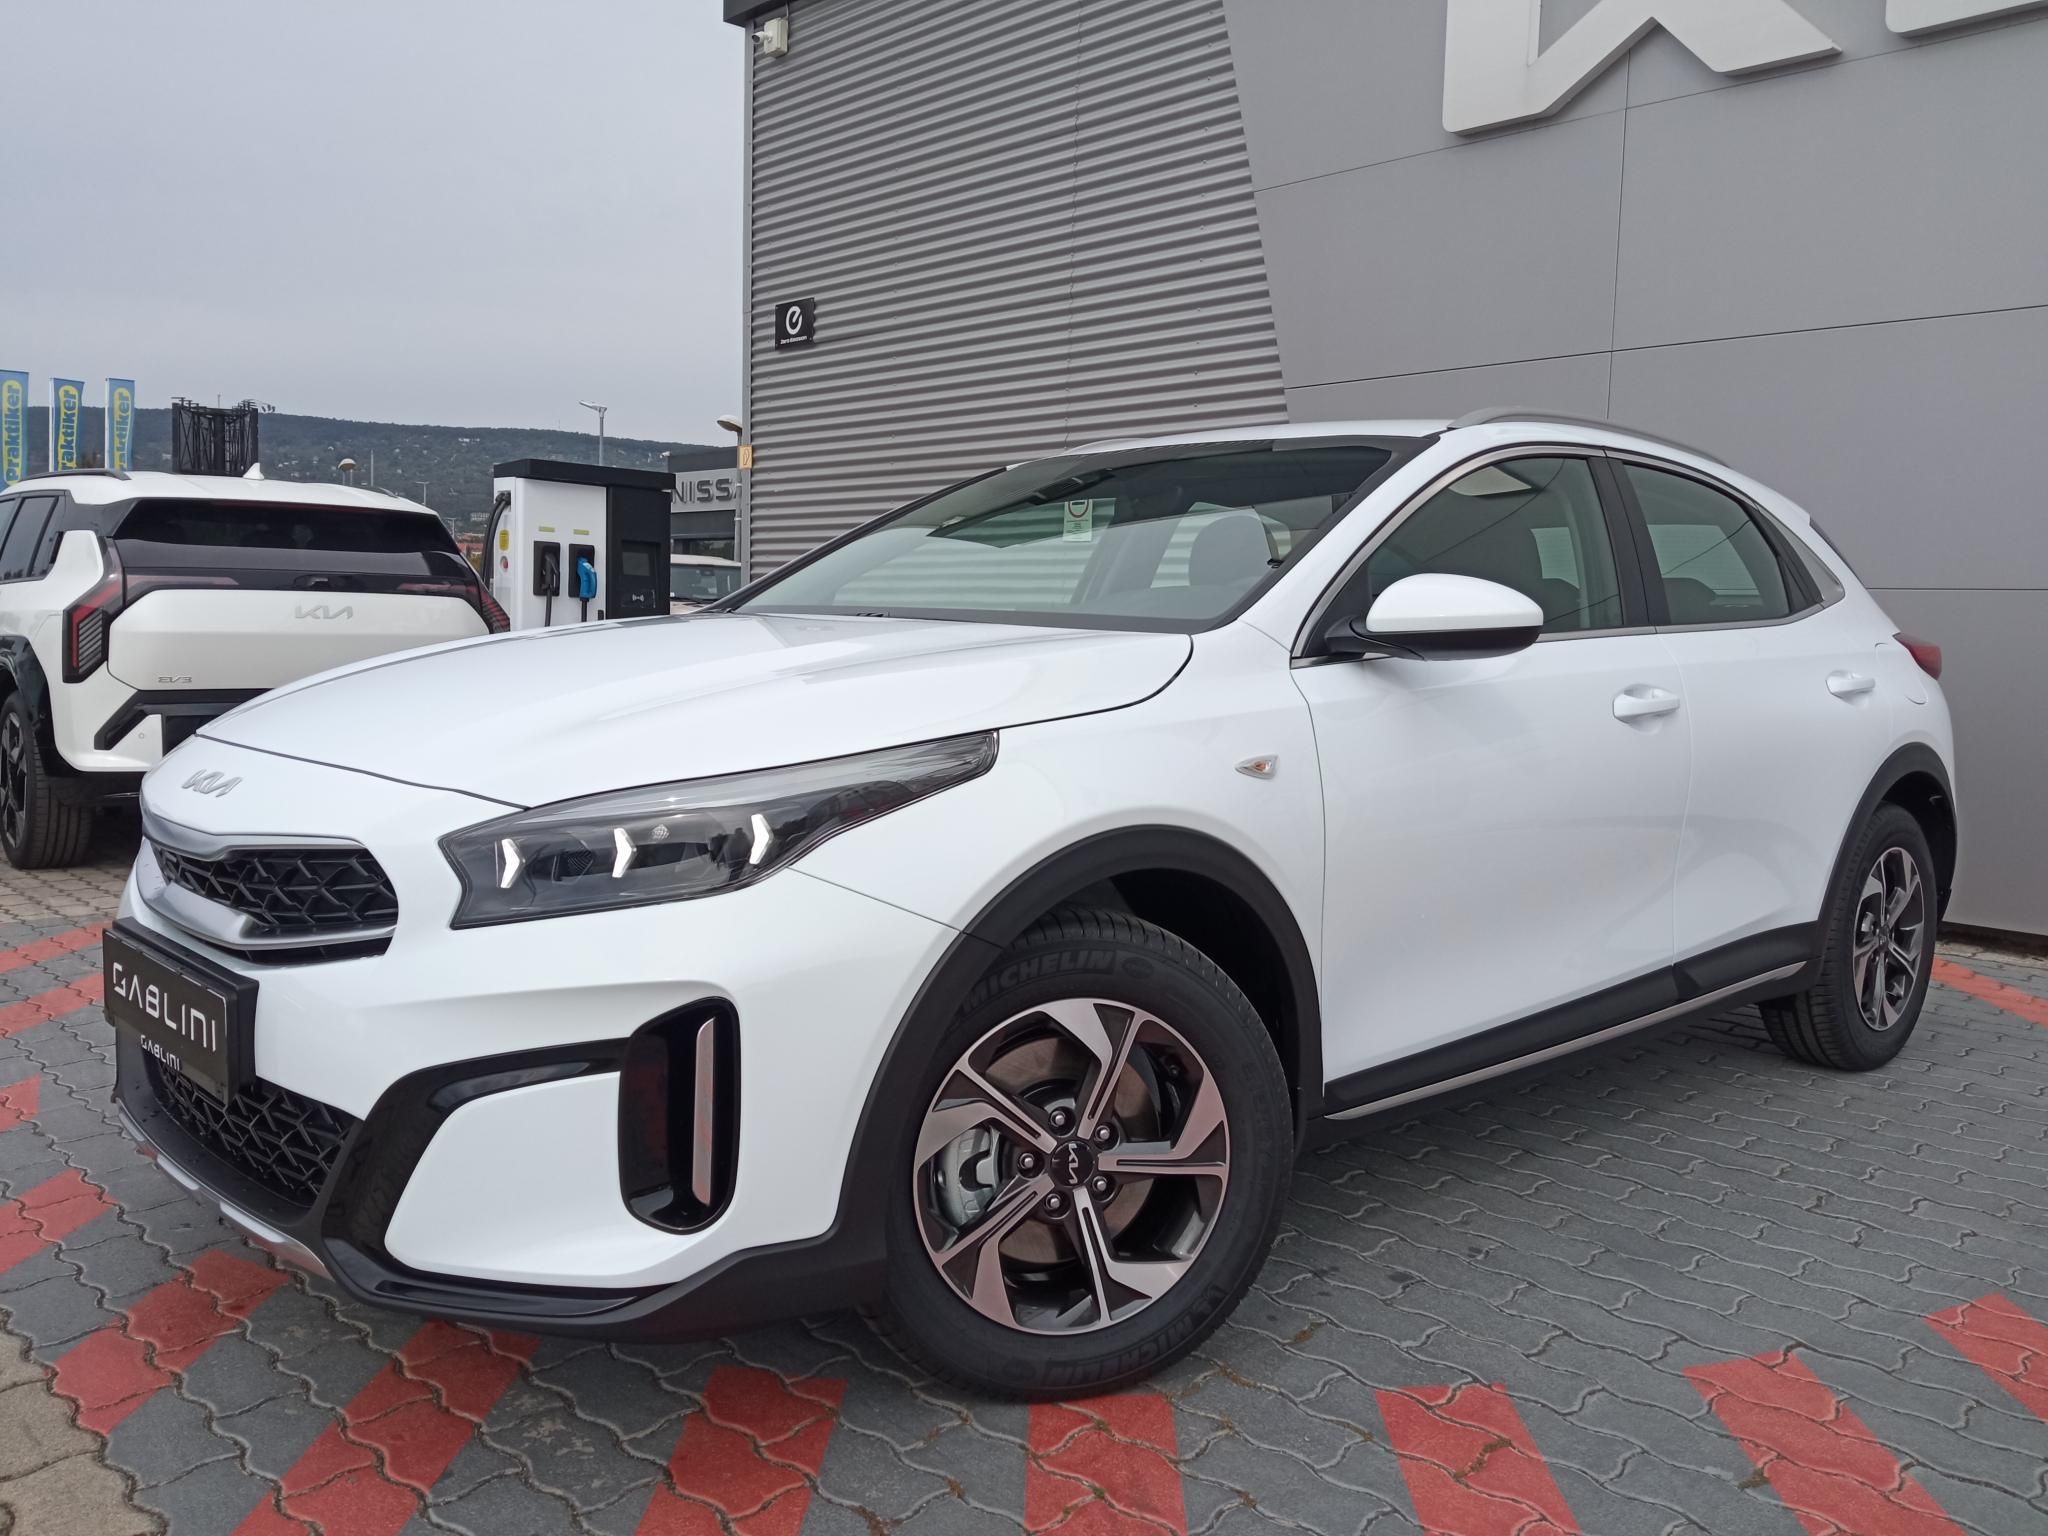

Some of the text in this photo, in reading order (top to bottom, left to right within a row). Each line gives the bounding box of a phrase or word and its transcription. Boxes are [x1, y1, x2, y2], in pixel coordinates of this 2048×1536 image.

[60, 389, 76, 471] raktiker
[116, 392, 130, 468] aktiker
[672, 478, 737, 504] NISS
[295, 604, 353, 620] KIA
[158, 675, 192, 684] EV3
[181, 768, 242, 797] KIA
[962, 950, 1114, 1014] MICHELIN
[112, 961, 216, 1052] GABLINI
[140, 1034, 181, 1071] GABLINI
[1067, 1142, 1079, 1186] KIA
